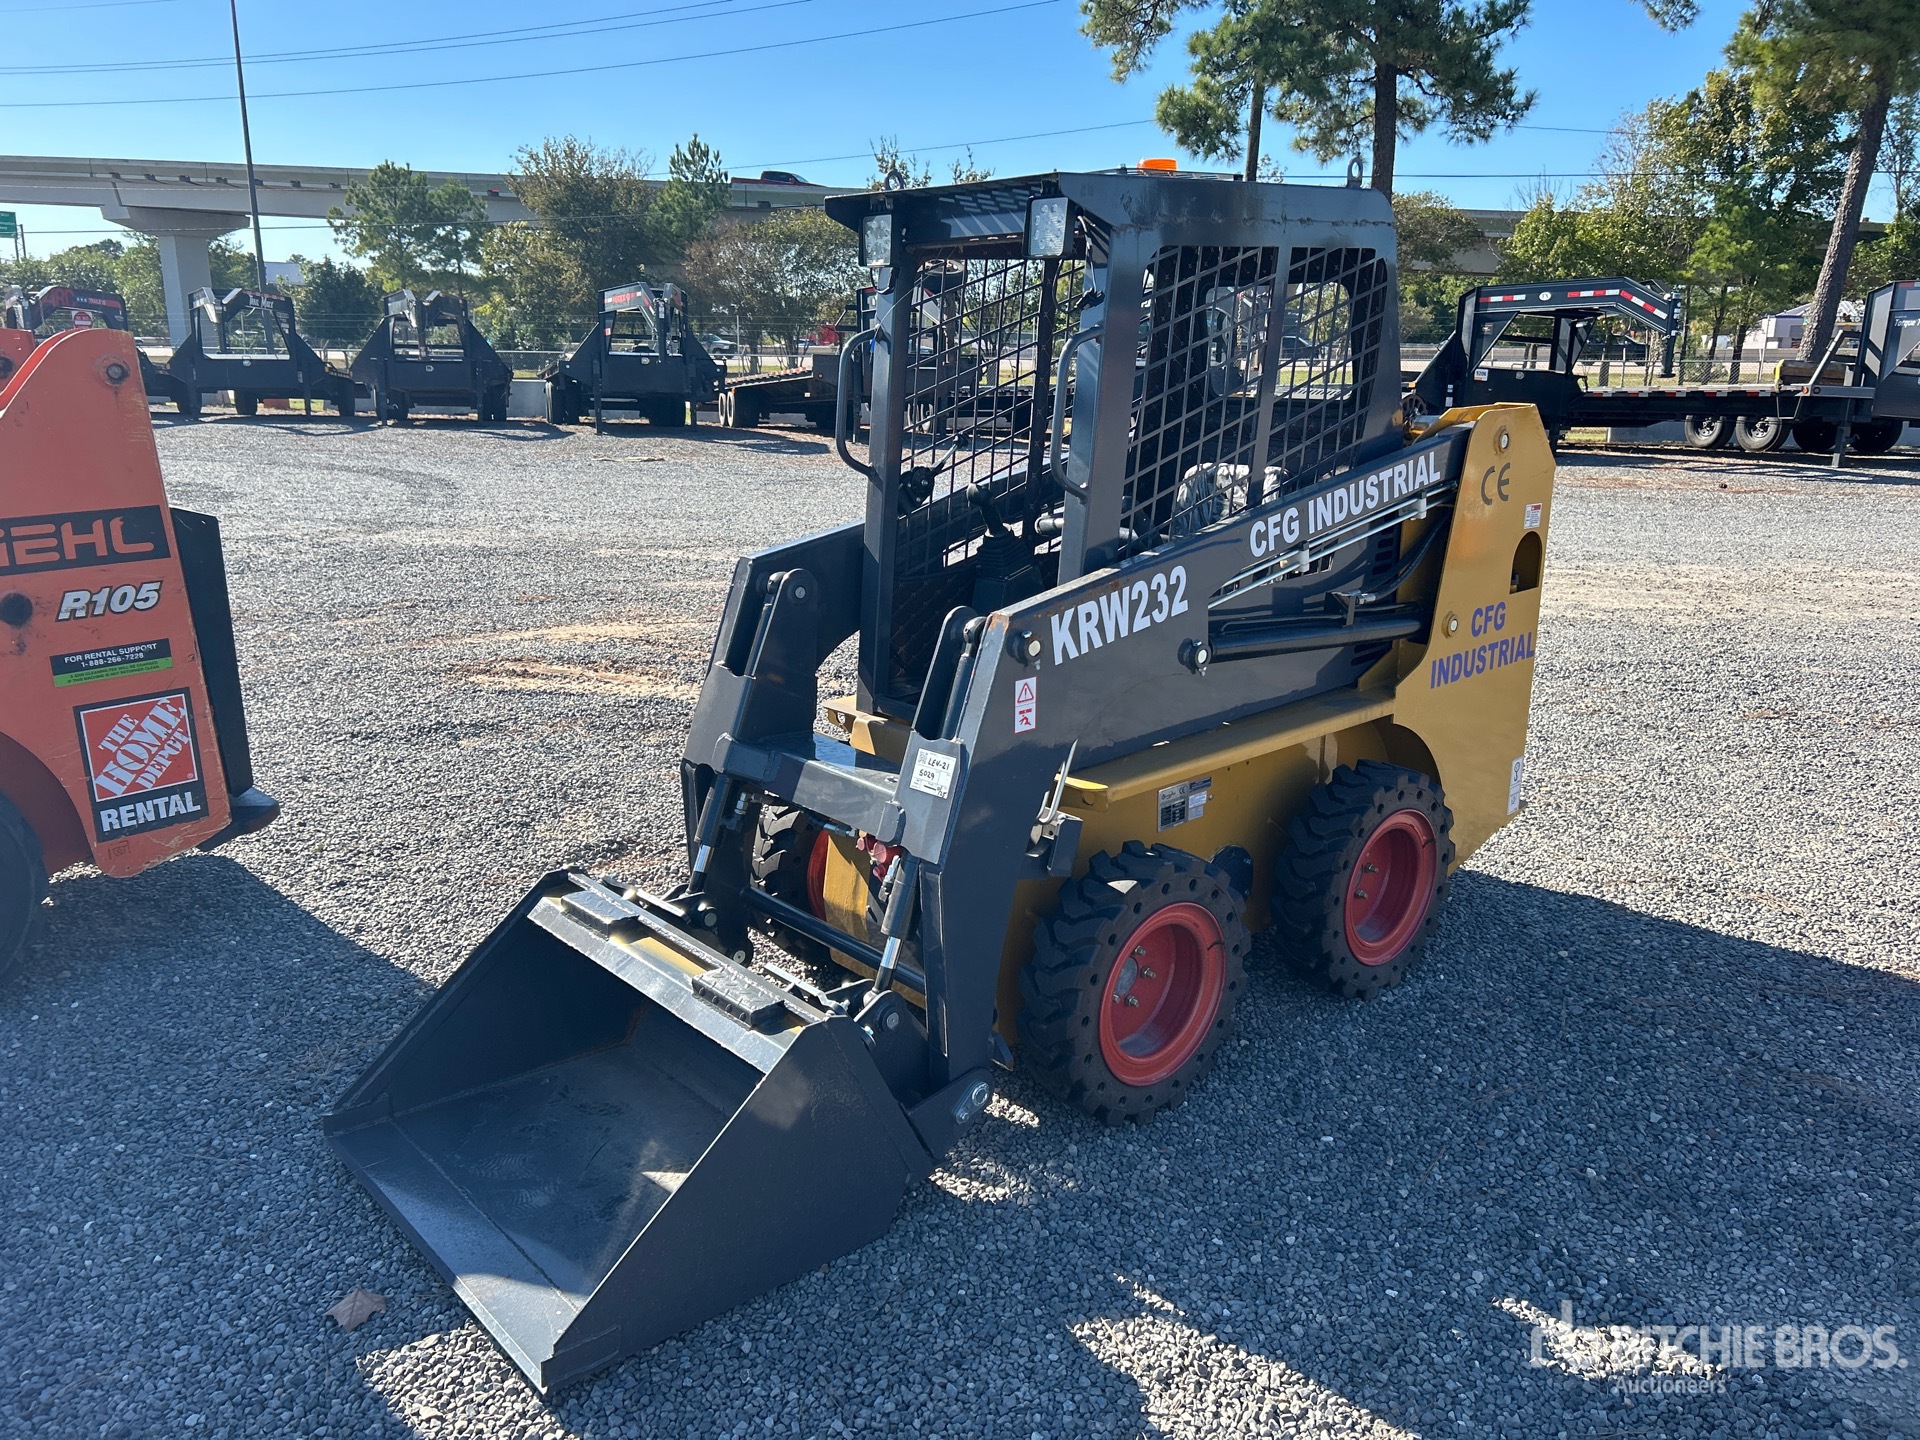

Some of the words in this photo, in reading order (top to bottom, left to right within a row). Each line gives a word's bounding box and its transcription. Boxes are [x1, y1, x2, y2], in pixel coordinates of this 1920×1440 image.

[1250, 507, 1299, 557] CFG
[1308, 451, 1441, 534] INDUSTRIAL
[0, 516, 154, 566] EHL
[57, 581, 161, 621] R105
[1051, 565, 1188, 665] KRW232
[1471, 601, 1506, 637] CFG
[64, 655, 82, 663] FOR
[84, 650, 117, 660] RENTAL
[118, 643, 157, 655] SUPPORT
[1430, 631, 1535, 689] INDUSTRIAL
[94, 698, 186, 795] HOME
[98, 713, 139, 753] THE
[136, 728, 190, 789] DEPOT
[919, 769, 935, 780] 5029
[100, 791, 201, 832] RENTAL
